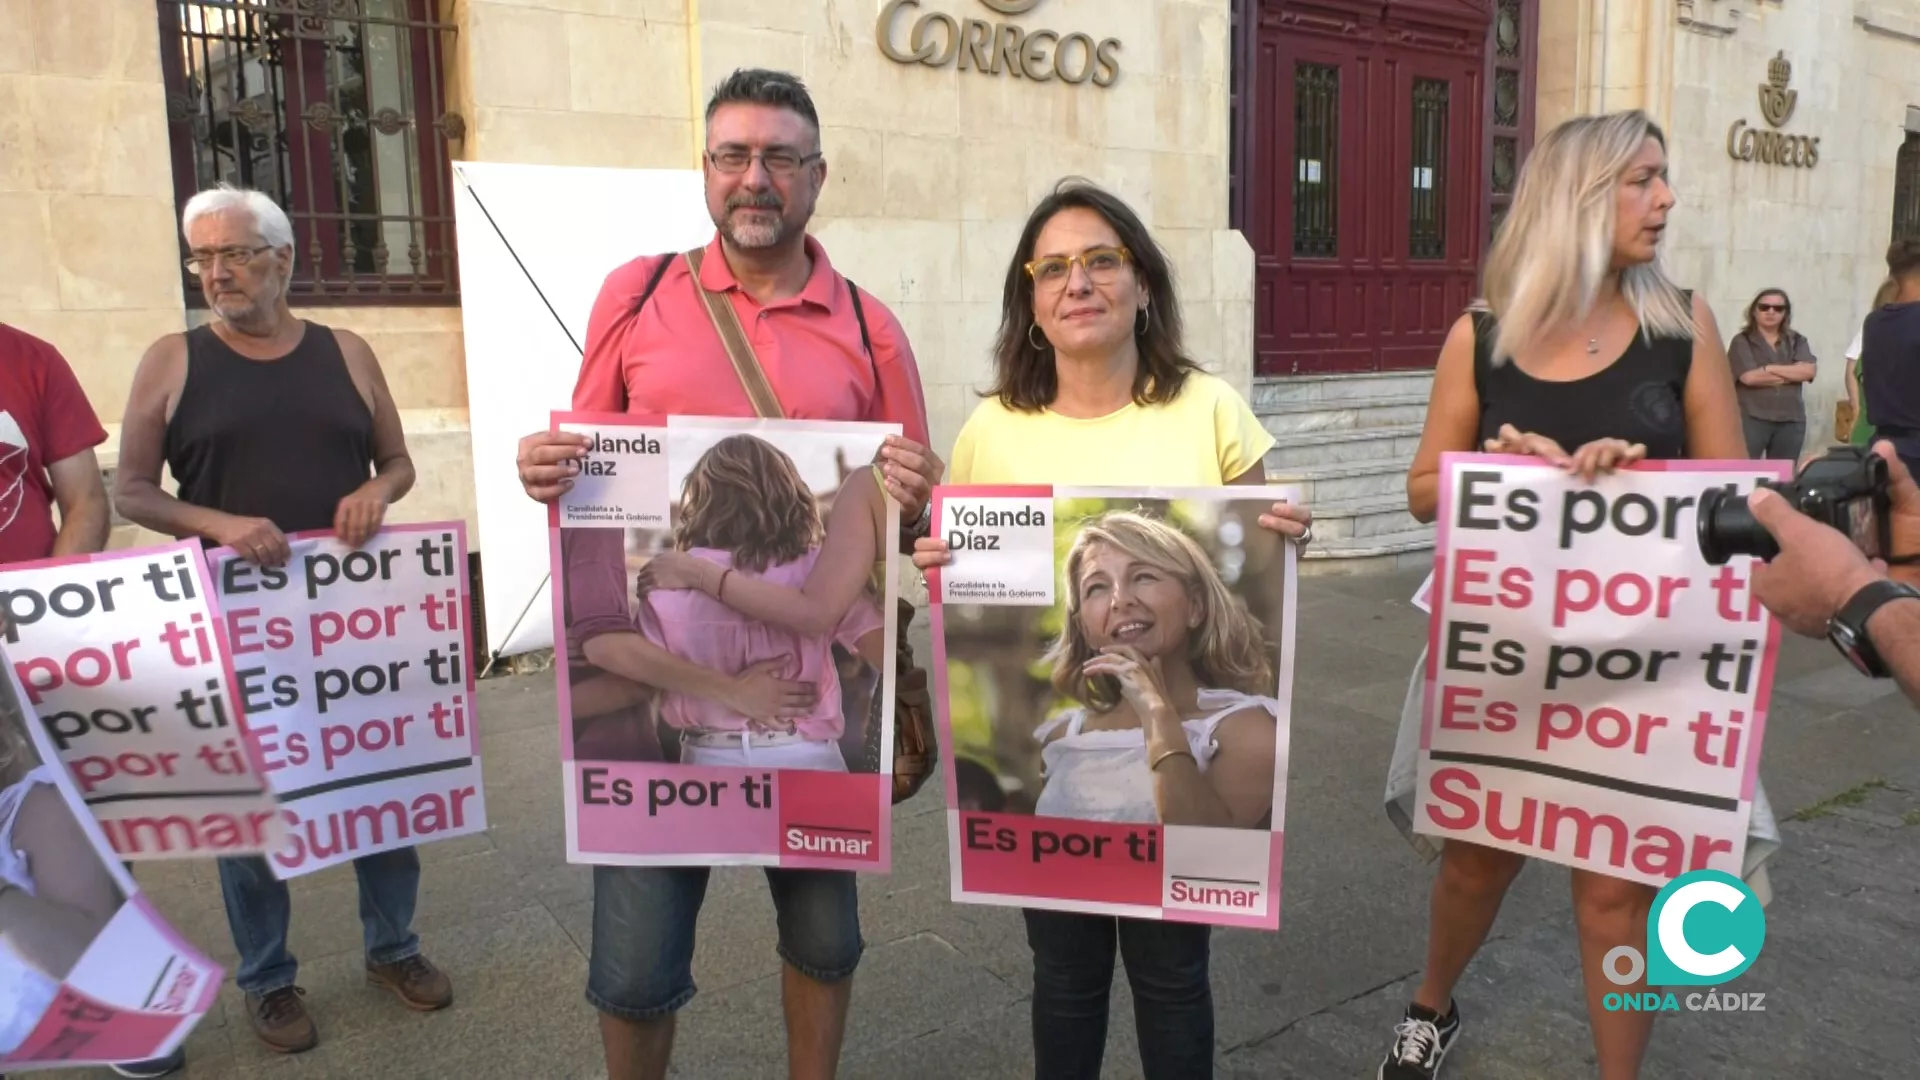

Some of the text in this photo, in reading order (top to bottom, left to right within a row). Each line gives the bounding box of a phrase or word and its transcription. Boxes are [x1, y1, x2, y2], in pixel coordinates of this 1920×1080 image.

[587, 432, 661, 454] landa
[948, 529, 1001, 551] Díaz
[950, 505, 1046, 527] Yolanda
[1457, 471, 1694, 549] Es por
[0, 554, 196, 643] por ti
[223, 533, 454, 599] Es por ti
[1451, 549, 1534, 609] Es
[1552, 569, 1690, 627] por
[226, 588, 457, 656] Es por ti
[14, 612, 213, 705] por ti
[237, 642, 461, 714] Es por ti
[1446, 621, 1758, 694] Es por ti
[40, 678, 229, 750] por ti
[250, 695, 465, 772] Es por ti
[1440, 685, 1744, 768] Es por ti
[69, 738, 247, 792] por ti
[582, 767, 772, 816] Es por ti
[103, 810, 275, 854] mar
[786, 828, 872, 855] Sumar
[966, 817, 1157, 863] Es por ti
[1426, 767, 1733, 879] Sumar
[1170, 880, 1259, 908] Sumar
